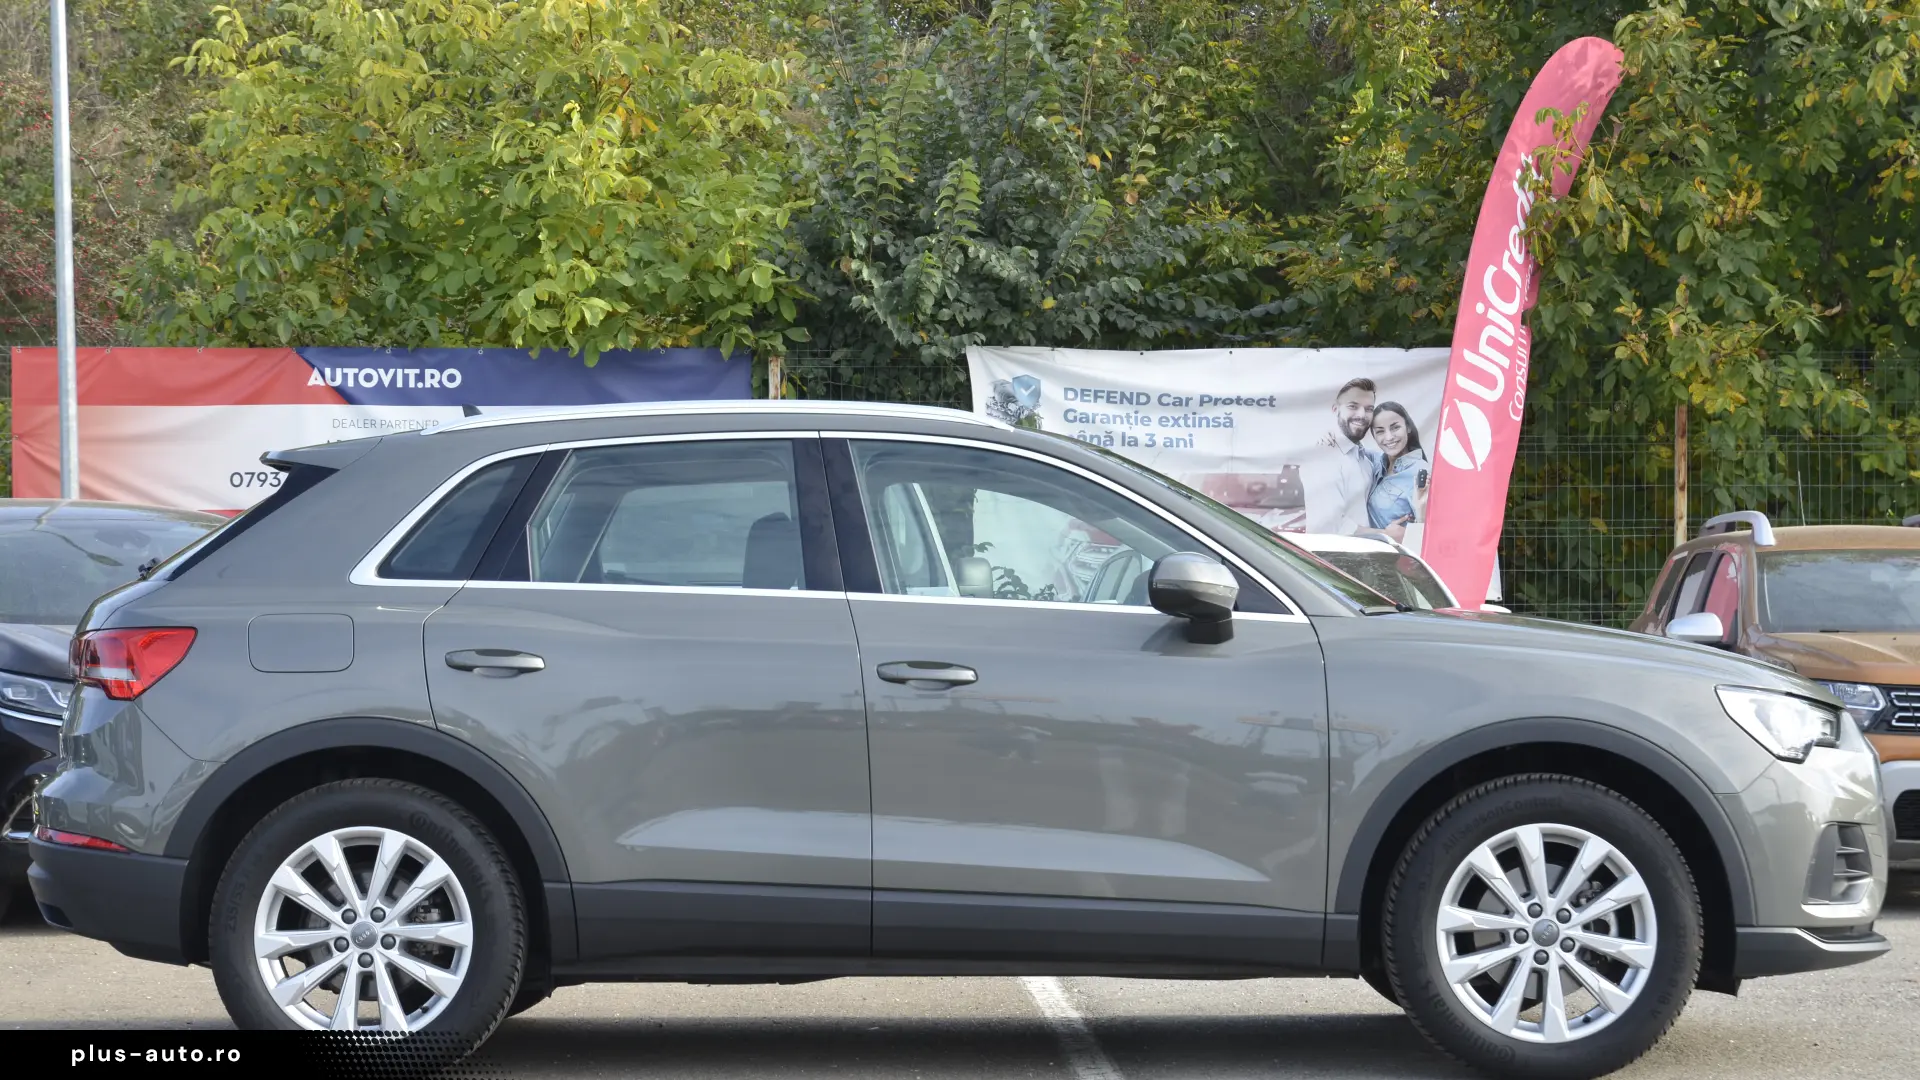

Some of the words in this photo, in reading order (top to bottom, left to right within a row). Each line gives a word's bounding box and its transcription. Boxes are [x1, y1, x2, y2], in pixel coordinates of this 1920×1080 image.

[307, 367, 462, 389] AUTOVIT.RO
[1063, 387, 1151, 406] DEFEND
[1157, 393, 1193, 407] Car
[1199, 394, 1276, 408] Protect
[332, 418, 377, 429] DEALER
[1063, 408, 1152, 430] Garanție
[1158, 412, 1234, 428] extinsă
[1068, 430, 1115, 447] ână
[1121, 431, 1139, 447] la
[1144, 433, 1157, 447] 3
[1162, 433, 1194, 448] ani
[229, 471, 282, 488] 0793
